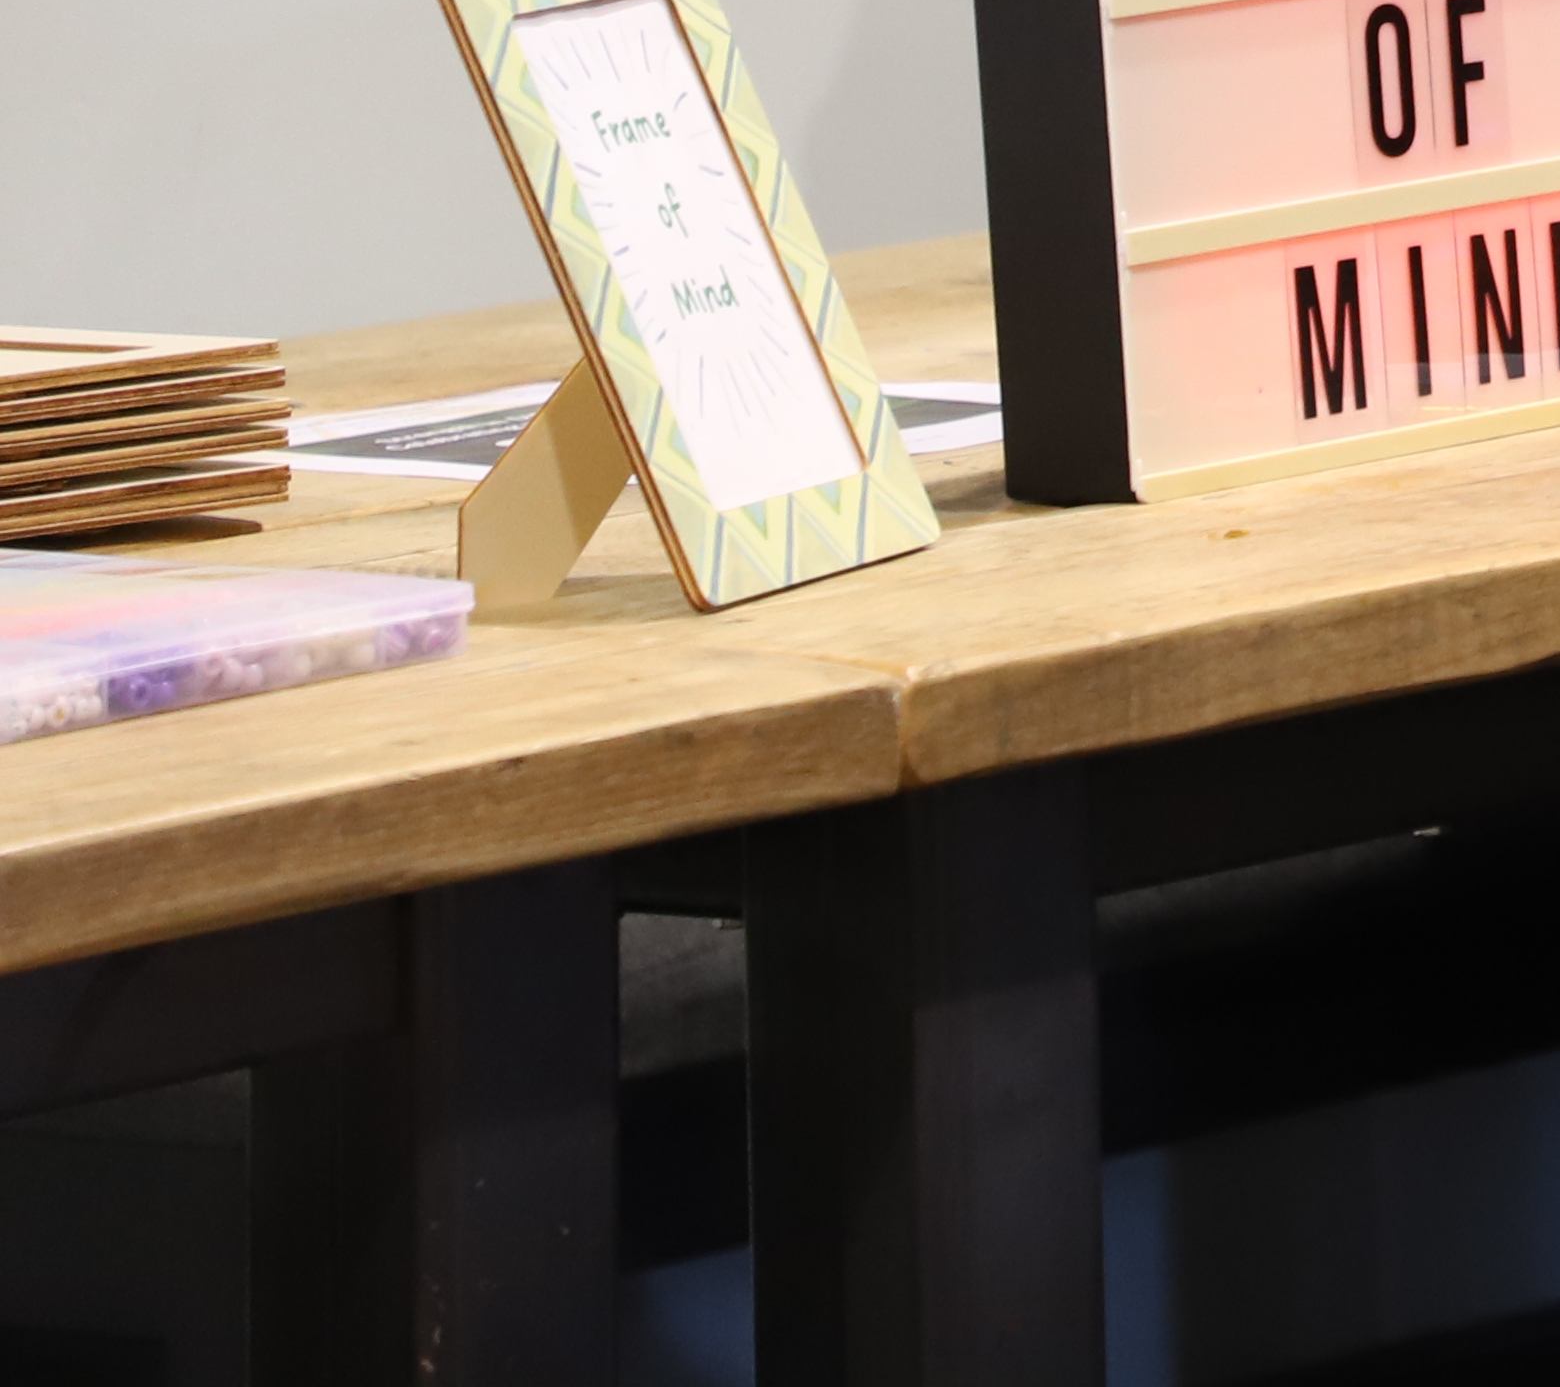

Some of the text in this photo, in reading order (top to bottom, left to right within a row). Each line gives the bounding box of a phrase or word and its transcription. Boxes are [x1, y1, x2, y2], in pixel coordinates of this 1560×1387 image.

[591, 110, 672, 153] Frame
[658, 182, 689, 239] of
[670, 264, 741, 321] Mind
